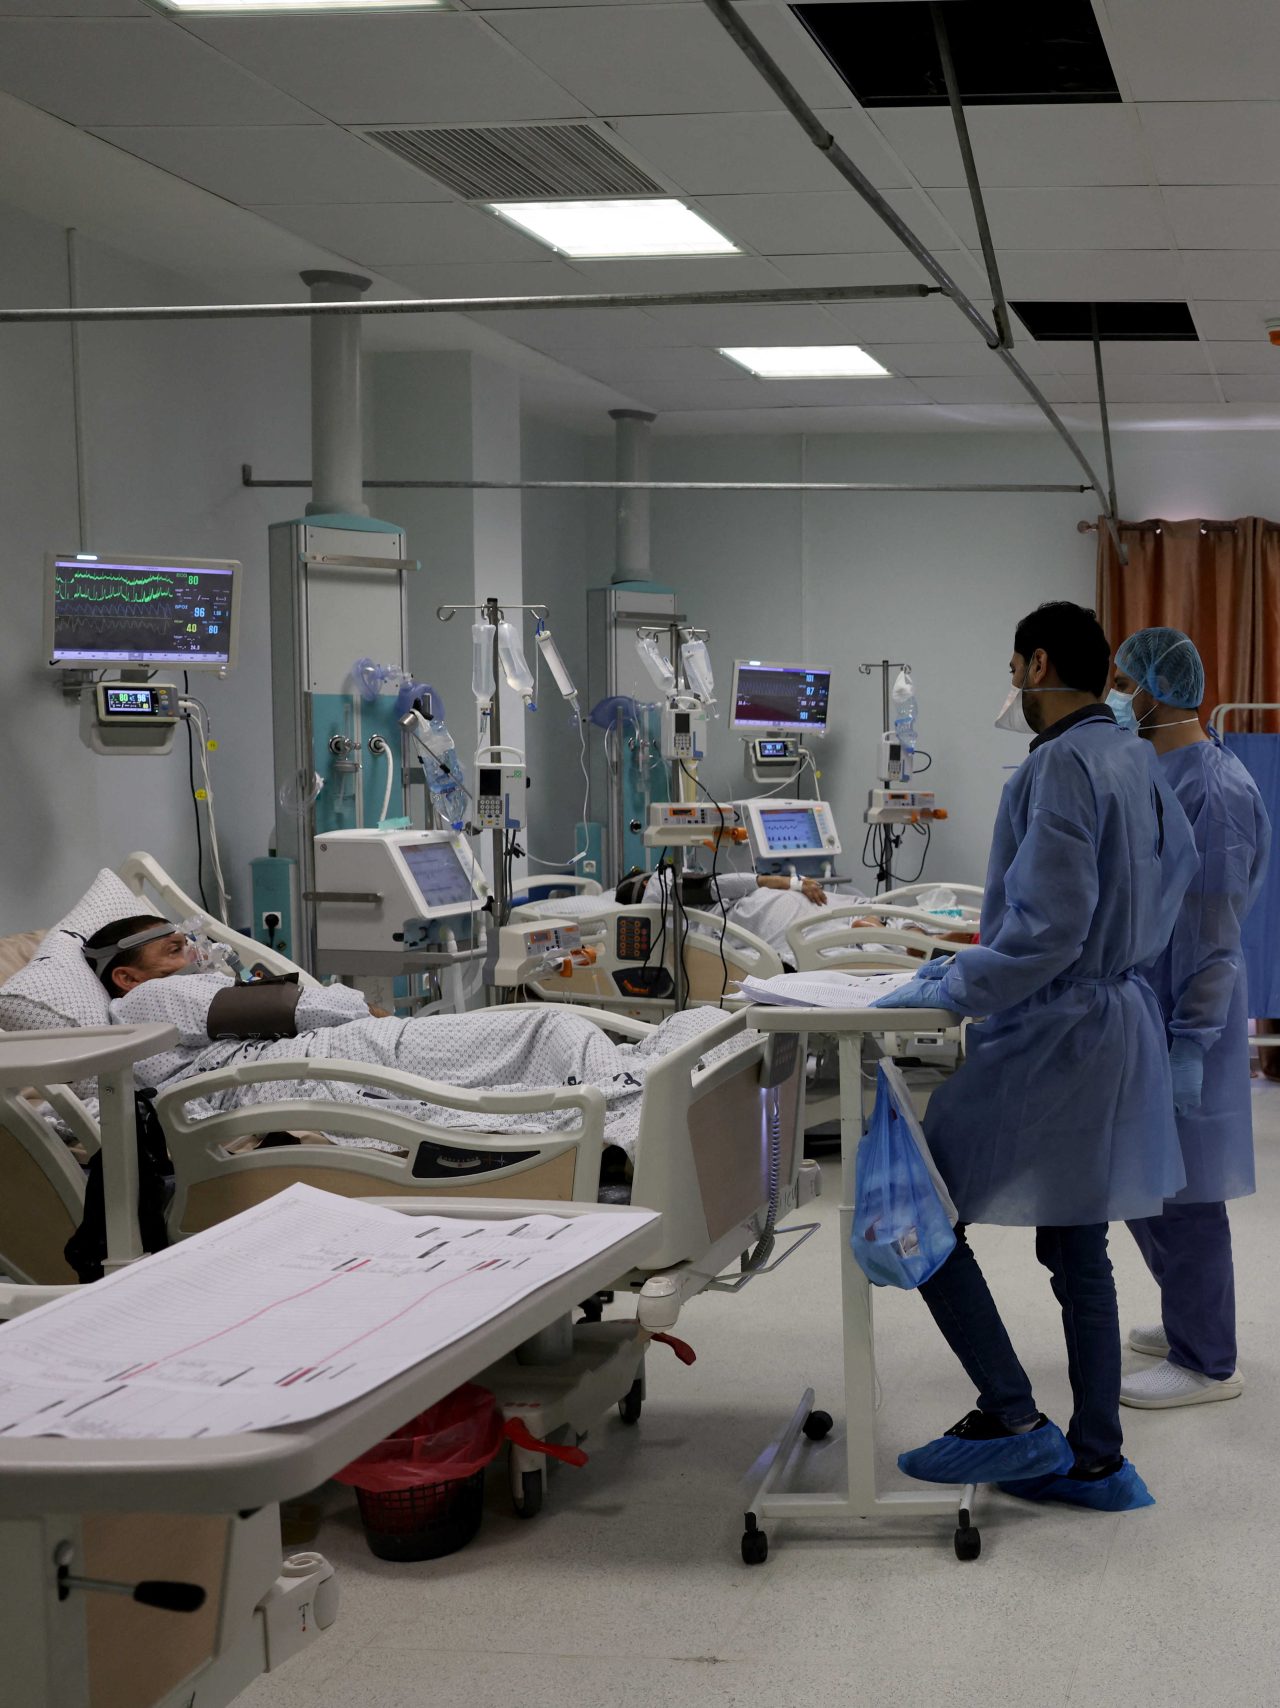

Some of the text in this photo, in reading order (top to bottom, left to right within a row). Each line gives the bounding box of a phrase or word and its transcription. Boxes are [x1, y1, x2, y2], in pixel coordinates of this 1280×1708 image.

[188, 575, 199, 585] 80
[186, 623, 197, 632] 40
[119, 693, 129, 702] 80
